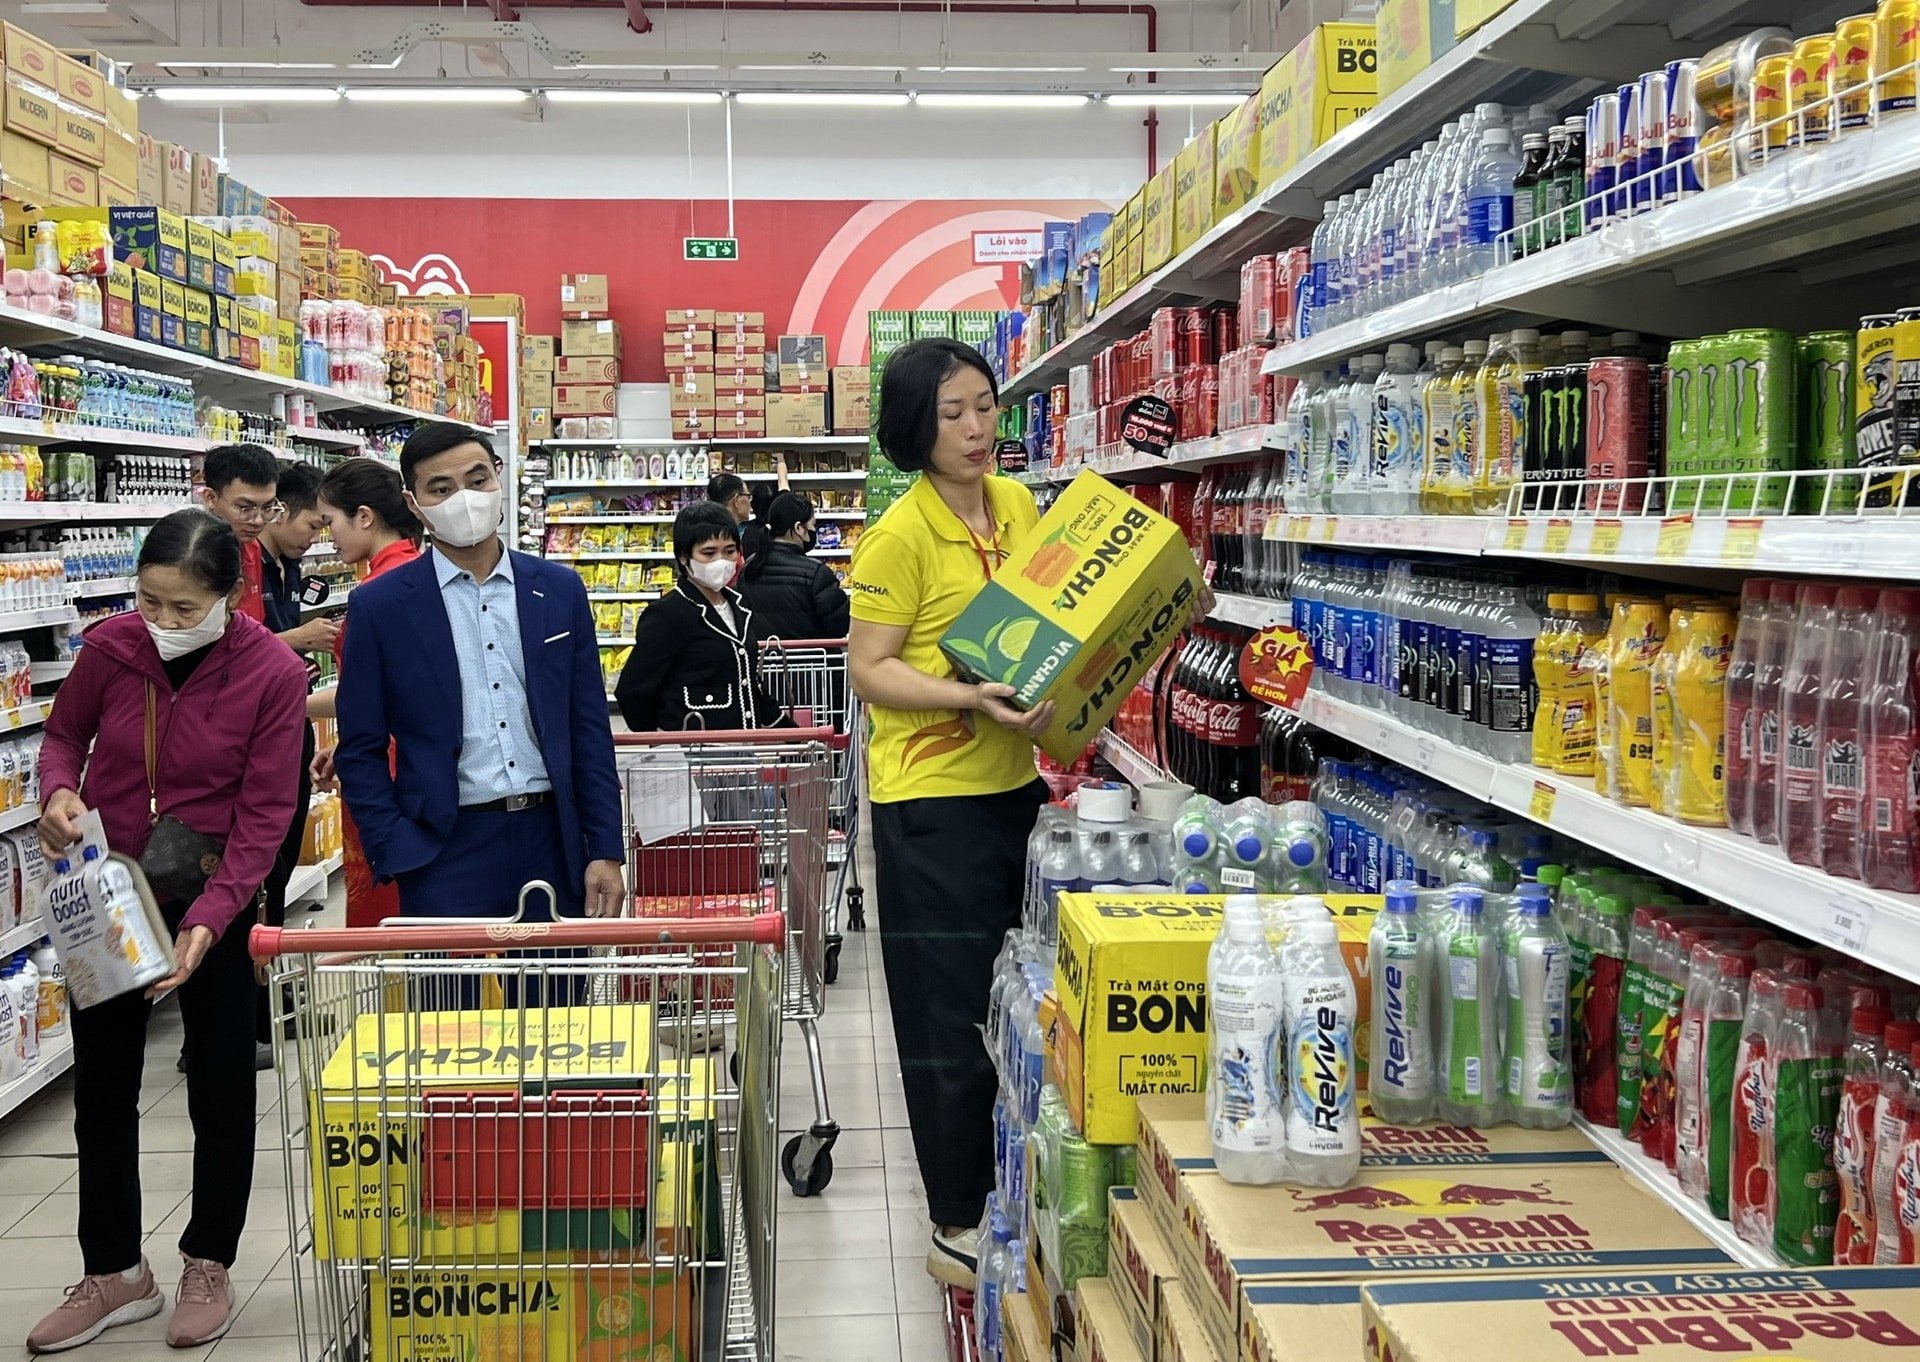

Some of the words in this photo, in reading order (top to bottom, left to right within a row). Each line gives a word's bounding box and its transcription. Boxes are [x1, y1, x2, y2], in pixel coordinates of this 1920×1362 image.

[20, 96, 48, 121] MODERN
[67, 120, 96, 144] MODERN
[1123, 423, 1148, 442] 50
[1052, 506, 1149, 612] BONCHA
[1261, 638, 1302, 668] GIÁ
[50, 872, 86, 903] nutri
[52, 894, 92, 923] boost
[1058, 929, 1083, 1004] BONCHA
[1354, 956, 1371, 978] V
[1108, 980, 1132, 991] Trà
[1138, 980, 1168, 994] Mật
[1174, 980, 1206, 994] Ong
[1107, 994, 1207, 1034] BON
[357, 1041, 627, 1068] BONCHA
[1140, 1054, 1177, 1066] 100%
[1136, 1070, 1162, 1082] nguyên
[1160, 1083, 1191, 1094] ONG
[1410, 1152, 1494, 1166] Drink
[1367, 1255, 1490, 1270] Energy
[1506, 1251, 1600, 1266] Drink
[1538, 1280, 1662, 1296] Drink
[1674, 1274, 1827, 1291] Energy
[385, 1281, 562, 1318] BONCHA
